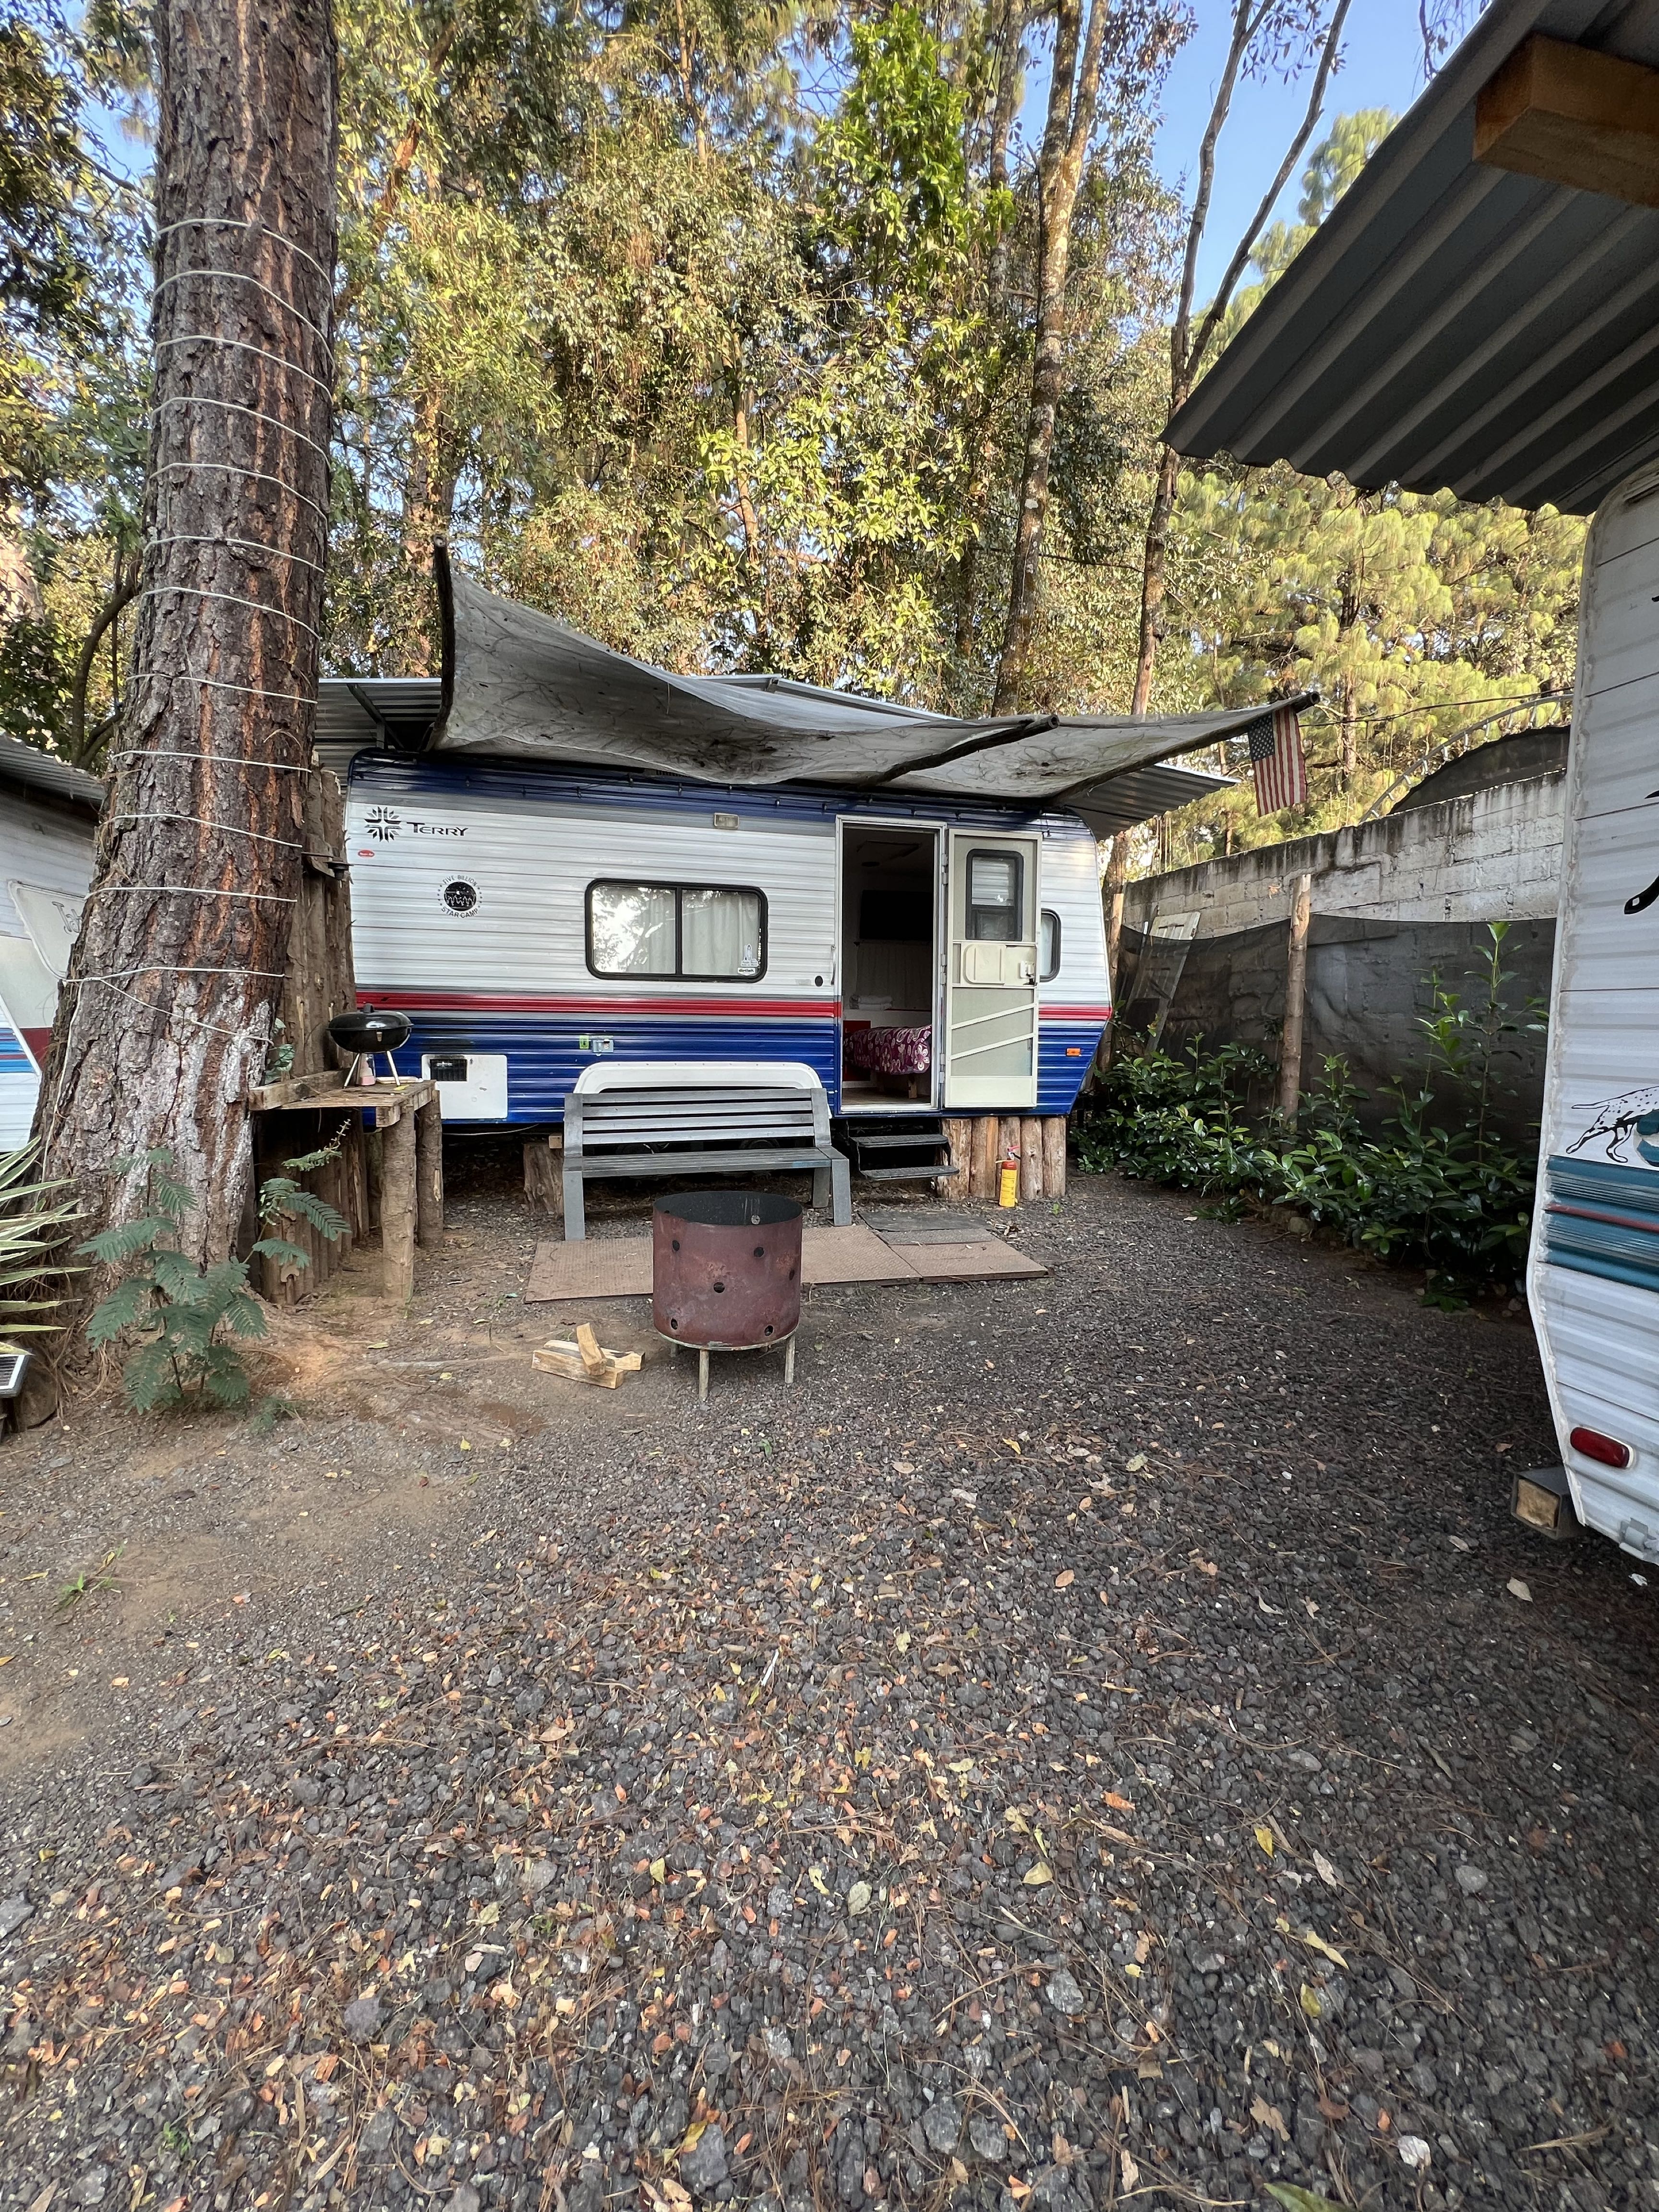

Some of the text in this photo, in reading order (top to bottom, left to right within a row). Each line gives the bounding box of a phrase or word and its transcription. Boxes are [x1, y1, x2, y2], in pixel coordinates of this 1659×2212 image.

[442, 875, 478, 887] FIVE BILLION
[441, 906, 478, 918] STAR CAMP
